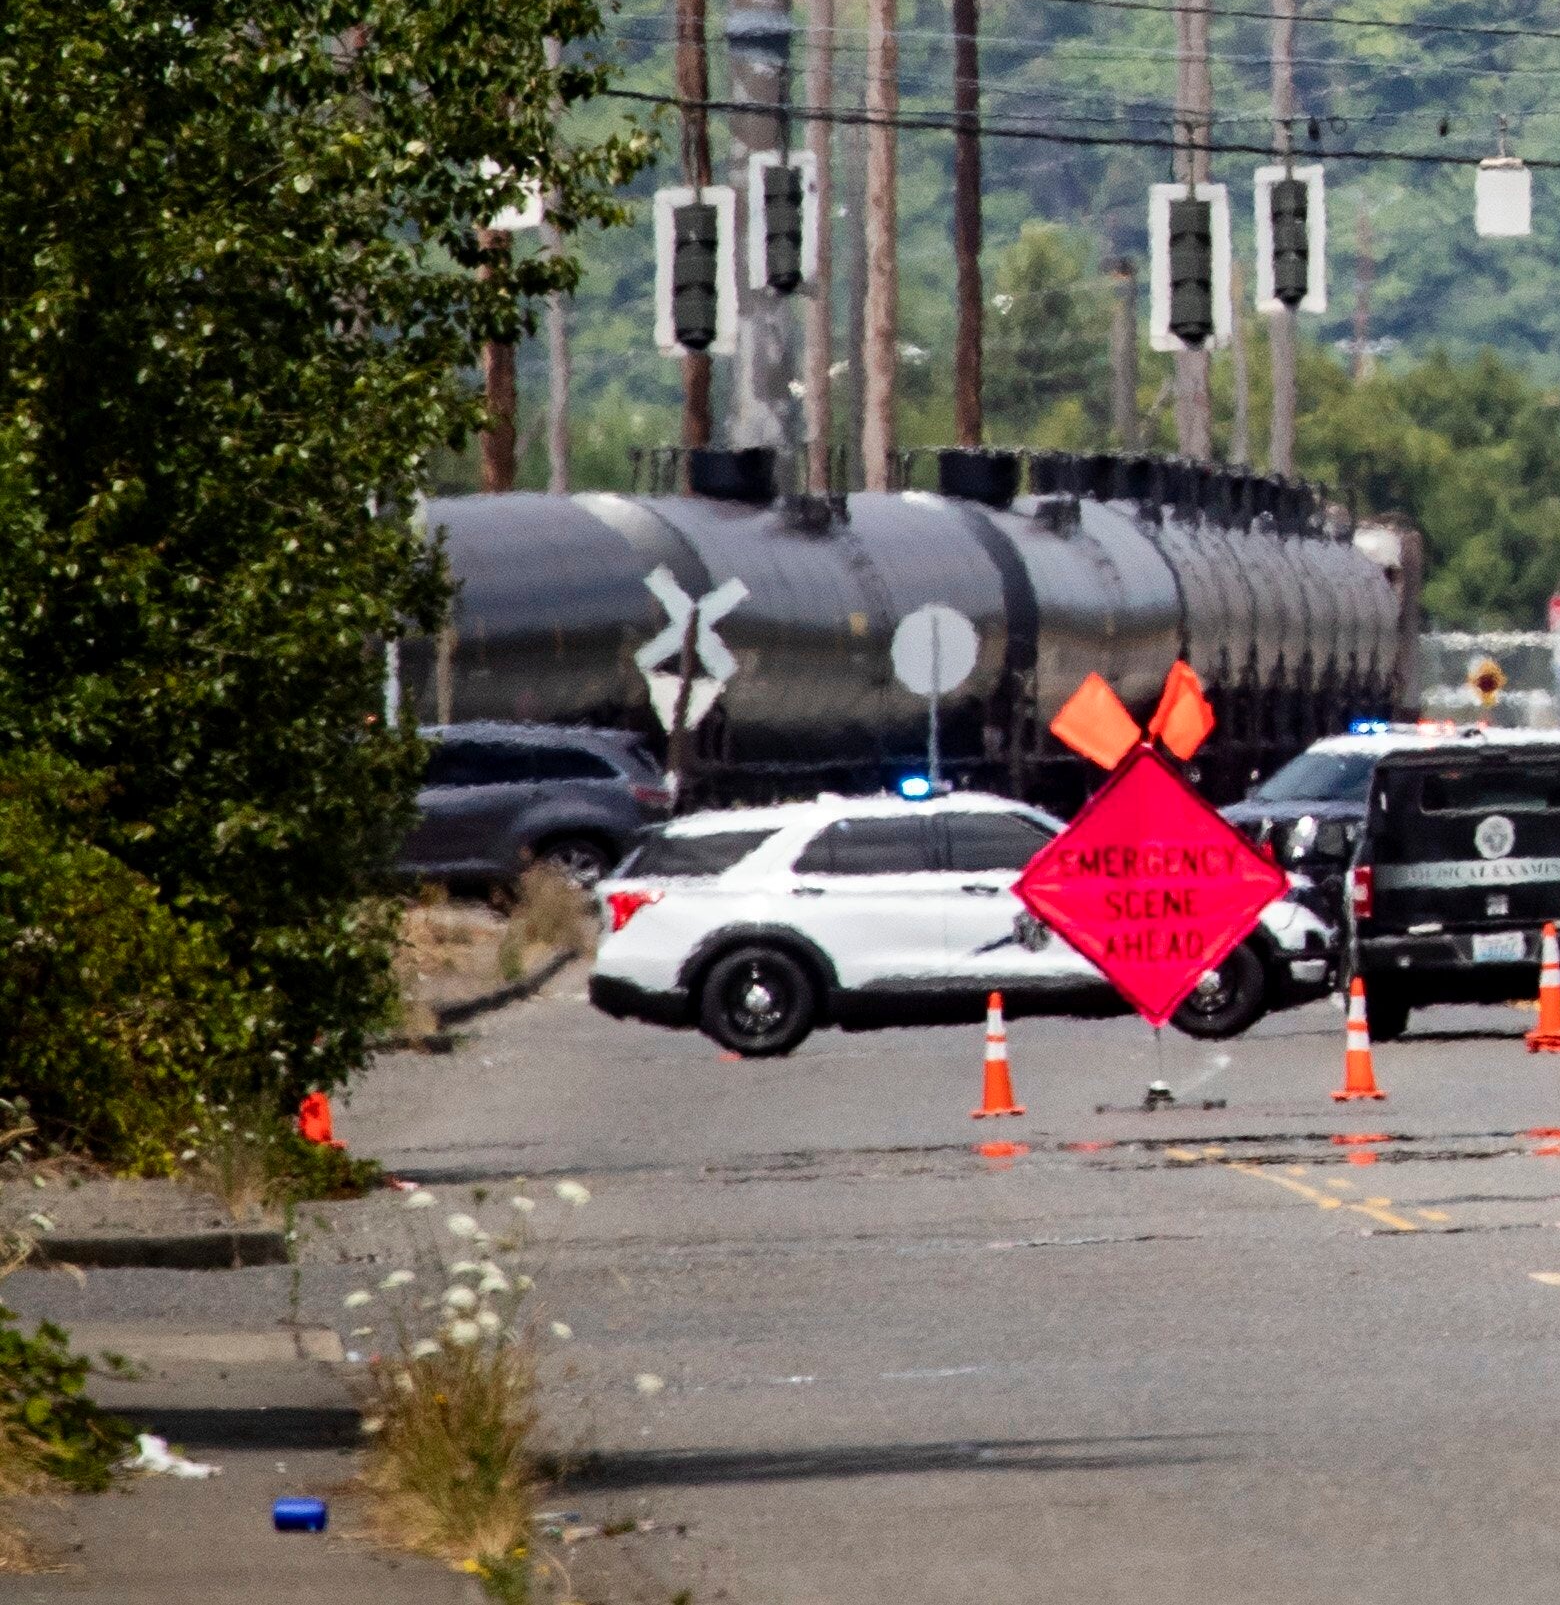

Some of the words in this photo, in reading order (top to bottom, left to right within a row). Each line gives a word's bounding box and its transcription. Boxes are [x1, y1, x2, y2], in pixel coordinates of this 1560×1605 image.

[1060, 844, 1239, 877] EMERGENCY
[1105, 888, 1198, 921] SCENE
[1104, 928, 1204, 962] AHEAD
